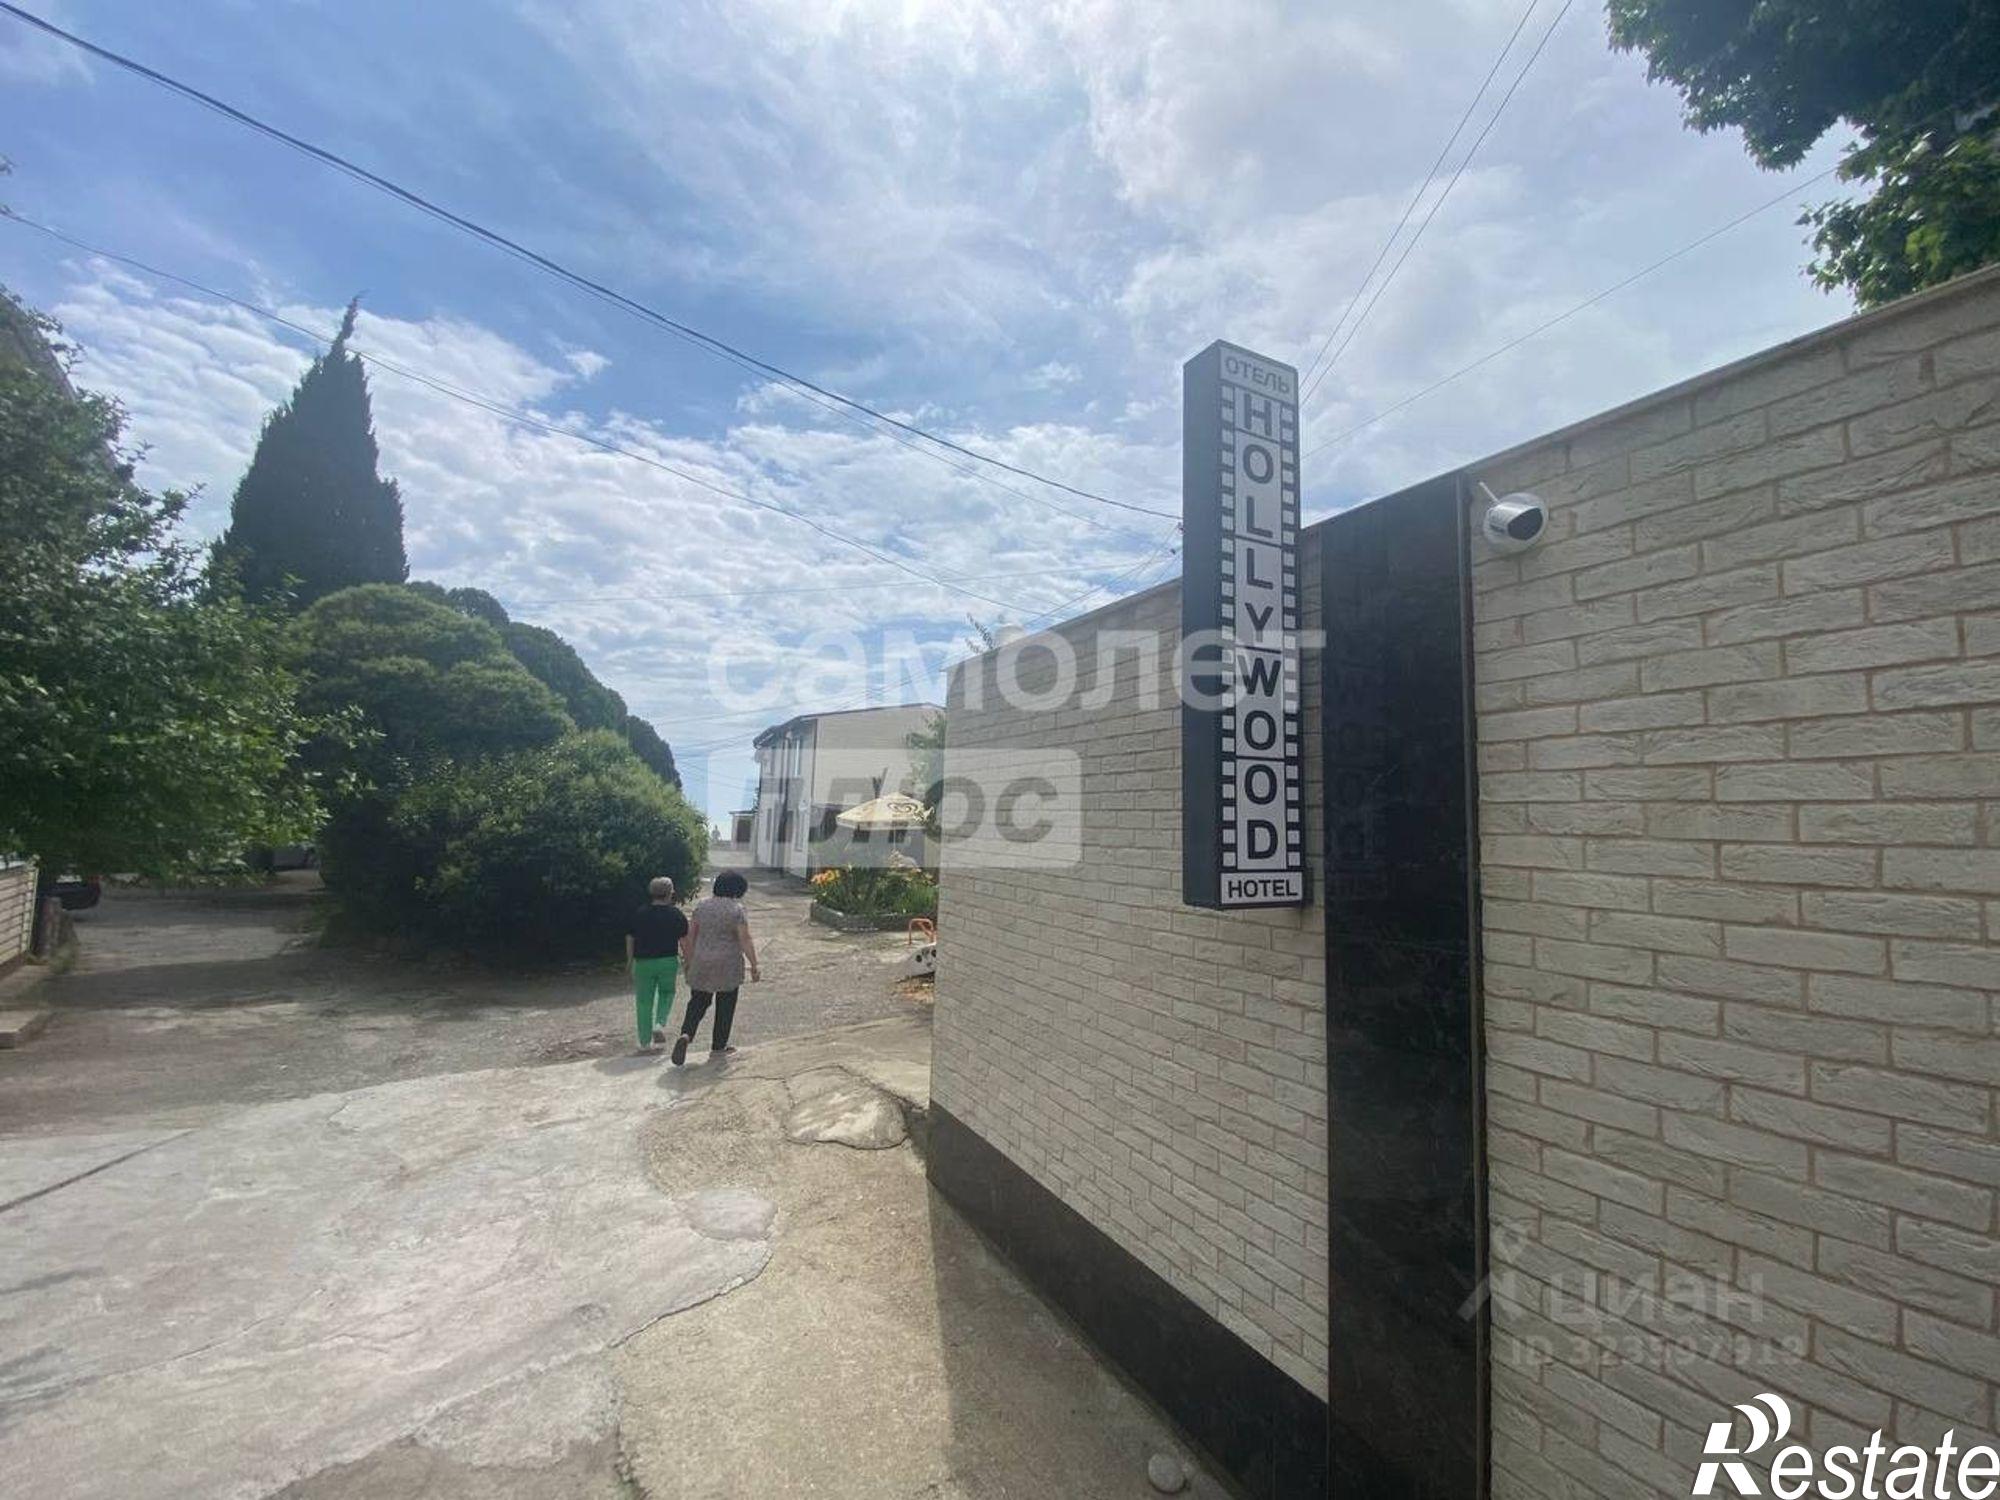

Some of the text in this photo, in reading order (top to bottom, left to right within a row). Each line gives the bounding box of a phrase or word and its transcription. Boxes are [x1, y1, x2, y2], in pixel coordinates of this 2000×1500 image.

[1225, 356, 1290, 394] ОТЕЛЬ
[1237, 393, 1282, 860] HOLLYWOOD
[1228, 879, 1298, 898] HOTEL
